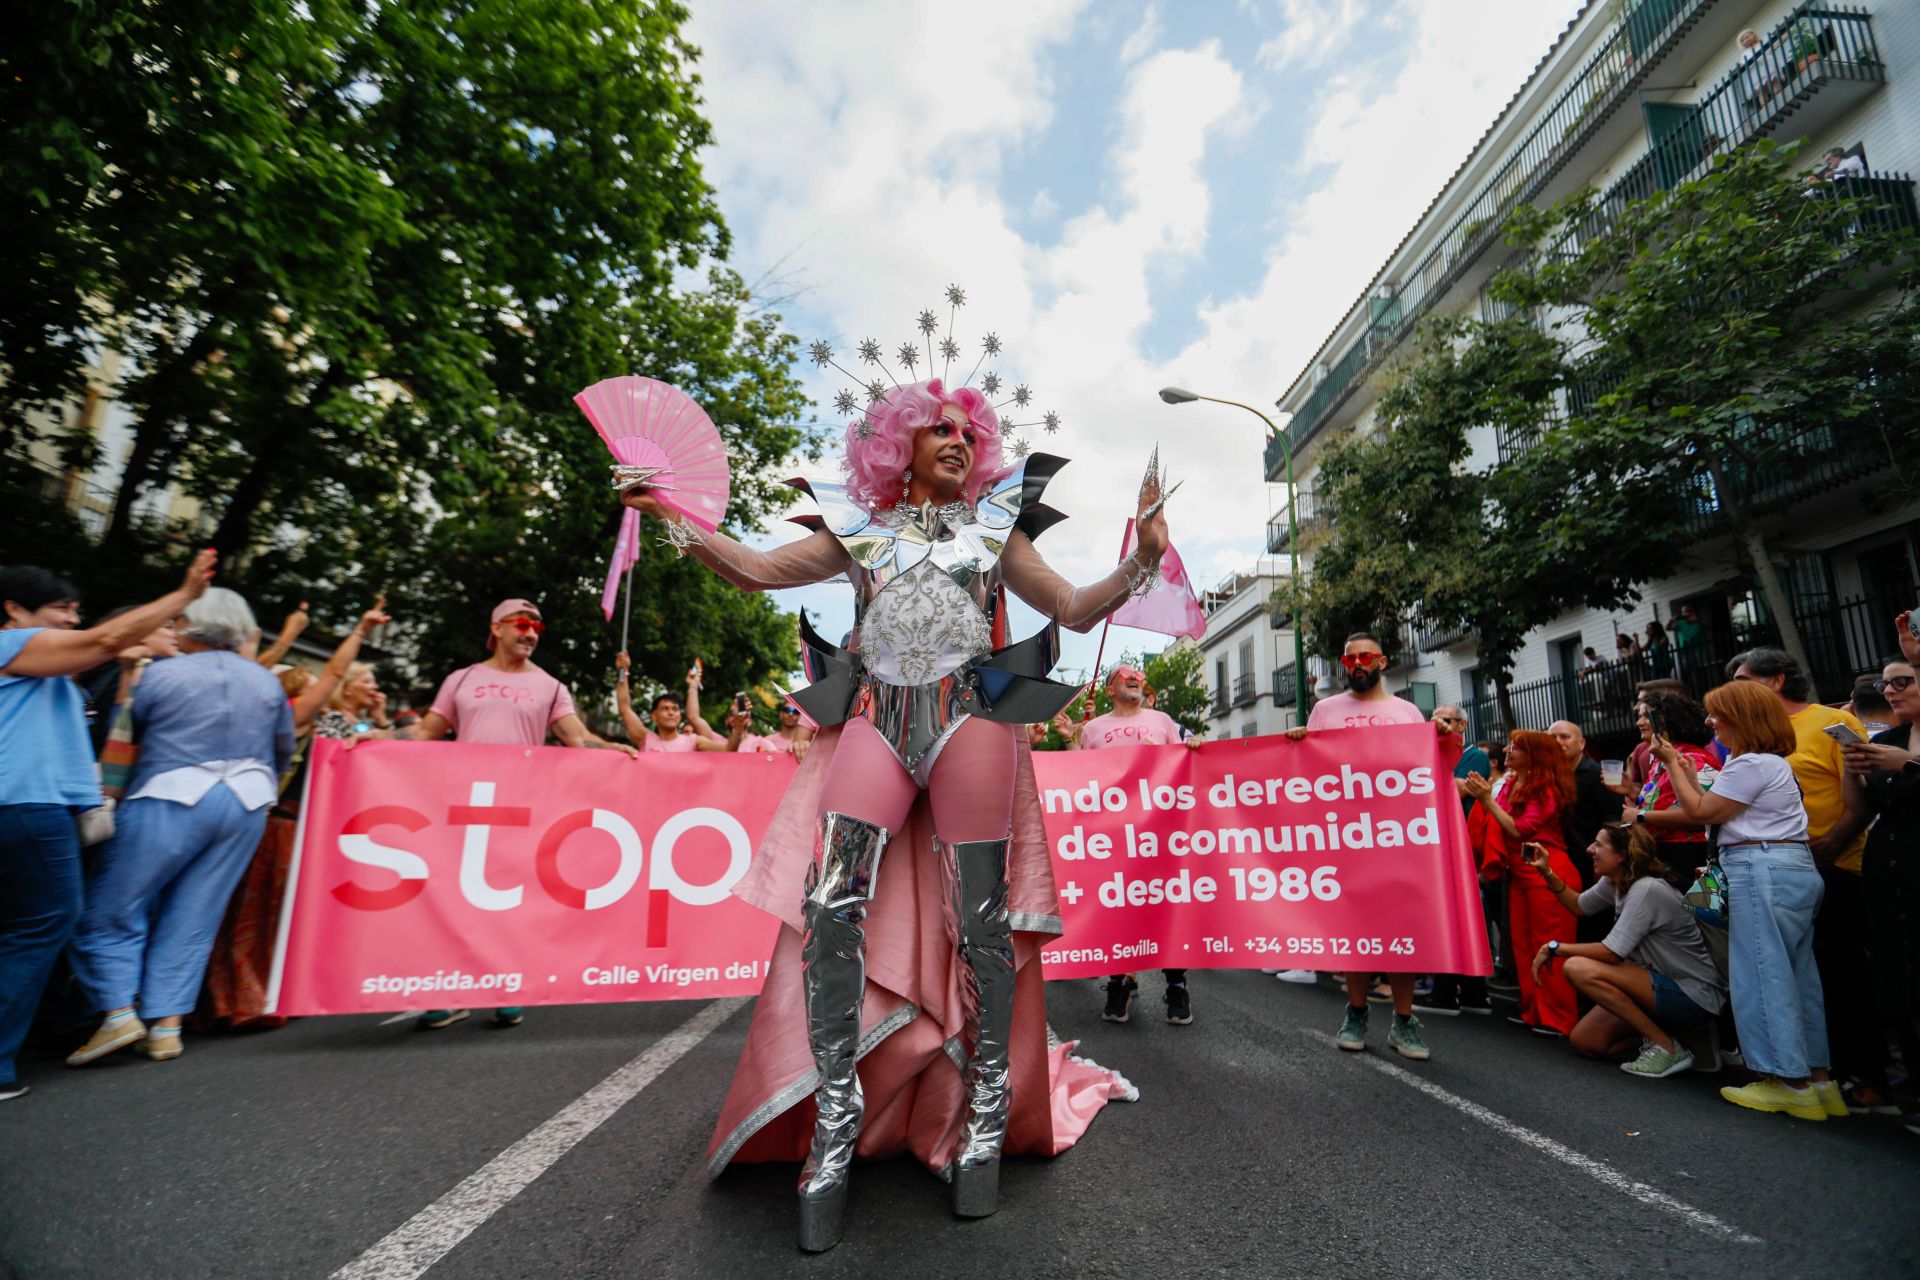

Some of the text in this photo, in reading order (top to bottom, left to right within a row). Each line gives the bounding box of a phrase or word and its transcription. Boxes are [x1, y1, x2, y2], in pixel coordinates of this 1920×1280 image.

[1039, 764, 1436, 813] ndo los derechos
[1057, 807, 1441, 861] de la comunidad
[331, 781, 752, 948] stop
[1098, 868, 1218, 908] desde
[1228, 865, 1342, 902] 1986
[1112, 939, 1159, 960] Sevilla
[1202, 936, 1416, 955] Tel. +34 955 12 05 43
[361, 970, 523, 997] stopsida.org
[582, 966, 641, 986] Calle
[646, 964, 720, 986] Virgen
[724, 961, 758, 980] del
